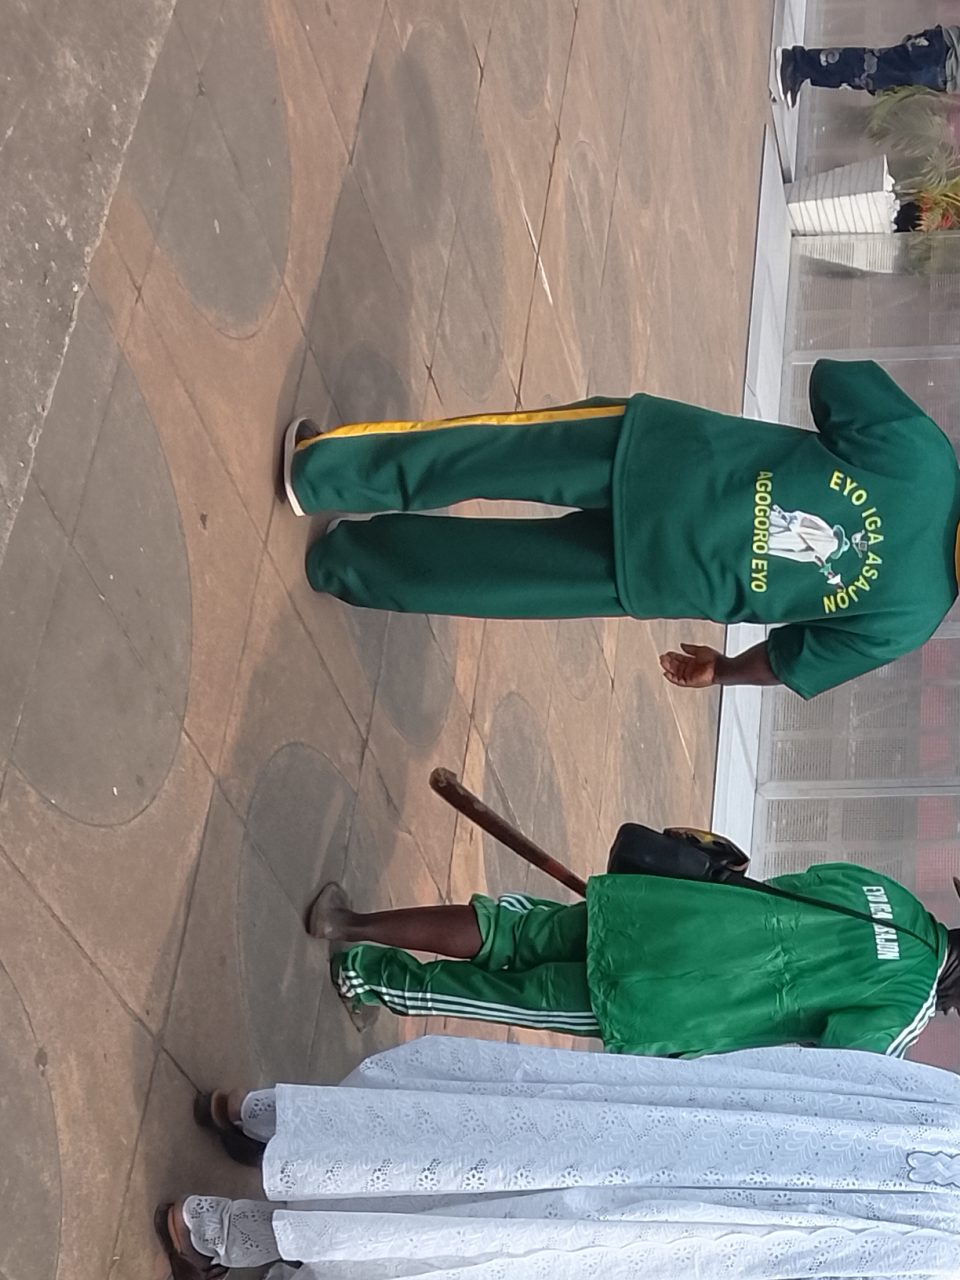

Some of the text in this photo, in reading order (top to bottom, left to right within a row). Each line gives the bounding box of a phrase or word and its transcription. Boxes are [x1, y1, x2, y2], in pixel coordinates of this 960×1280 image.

[750, 470, 774, 593] AGOGORO EYO
[822, 470, 884, 614] EYO IGA ASAJON
[862, 886, 889, 902] EYO
[868, 902, 894, 920] IGA
